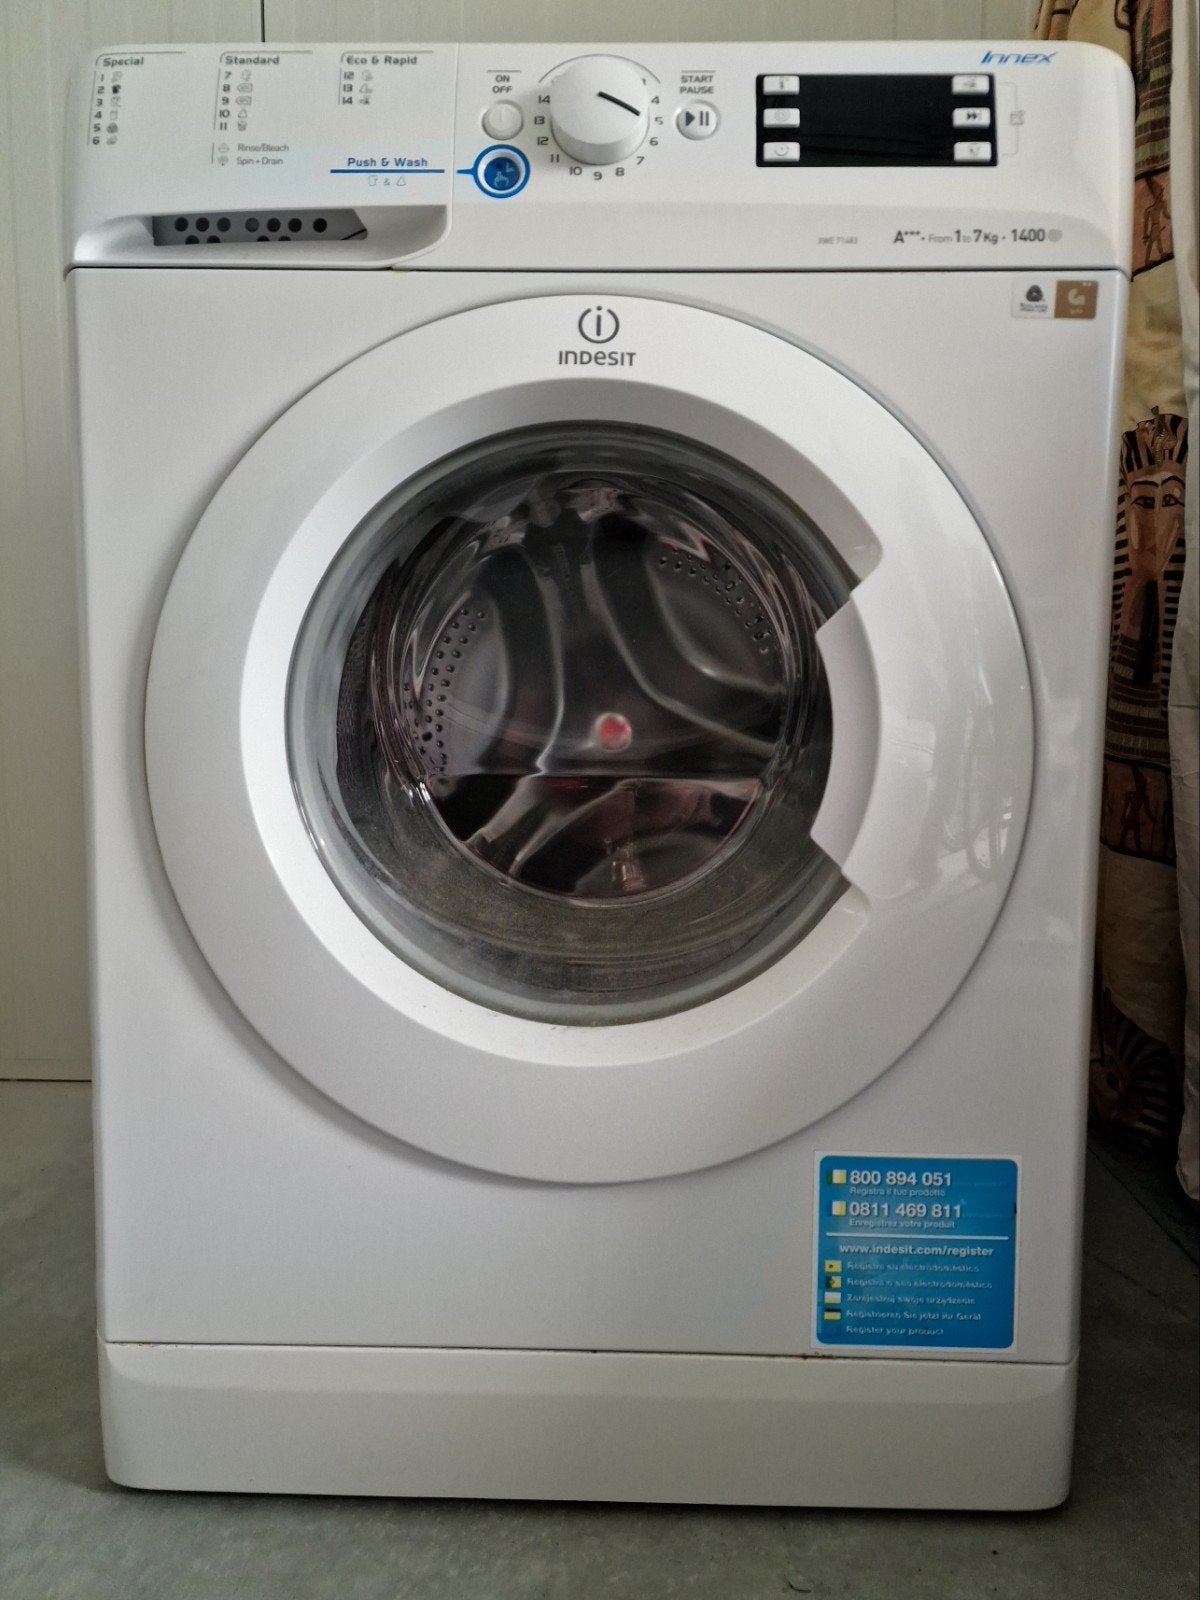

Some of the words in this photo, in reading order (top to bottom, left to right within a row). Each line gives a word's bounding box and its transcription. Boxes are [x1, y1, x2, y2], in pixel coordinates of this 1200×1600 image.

[225, 56, 279, 65] Standard
[347, 56, 367, 65] Eco
[384, 56, 418, 66] Rapid
[980, 50, 1057, 65] Innex
[103, 57, 144, 68] Special
[496, 75, 510, 83] ON
[681, 75, 714, 84] START
[223, 84, 230, 92] 8
[492, 86, 512, 94] OFF
[680, 86, 714, 94] PAUSE
[222, 97, 229, 105] 9
[538, 96, 550, 104] 14
[652, 96, 660, 104] 4
[219, 110, 230, 118] 10
[535, 117, 545, 125] 13
[655, 117, 663, 125] 5
[537, 137, 548, 145] 12
[650, 137, 658, 146] 6
[237, 157, 254, 165] Spin
[262, 157, 283, 165] Drain
[550, 154, 559, 162] 11
[637, 157, 645, 165] 7
[348, 158, 376, 167] Push
[381, 158, 389, 166] &
[394, 158, 428, 167] Wash
[570, 167, 582, 175] 10
[616, 168, 624, 176] 8
[594, 172, 602, 180] 9
[928, 234, 952, 243] From
[1011, 228, 1046, 242] 1400
[850, 1170, 881, 1185] 800
[886, 1171, 917, 1186] 894
[922, 1172, 951, 1186] 051
[850, 1202, 889, 1216] 0811
[895, 1203, 926, 1217] 469
[932, 1204, 960, 1218] 811
[840, 1244, 994, 1257] www.indesit.com/register
